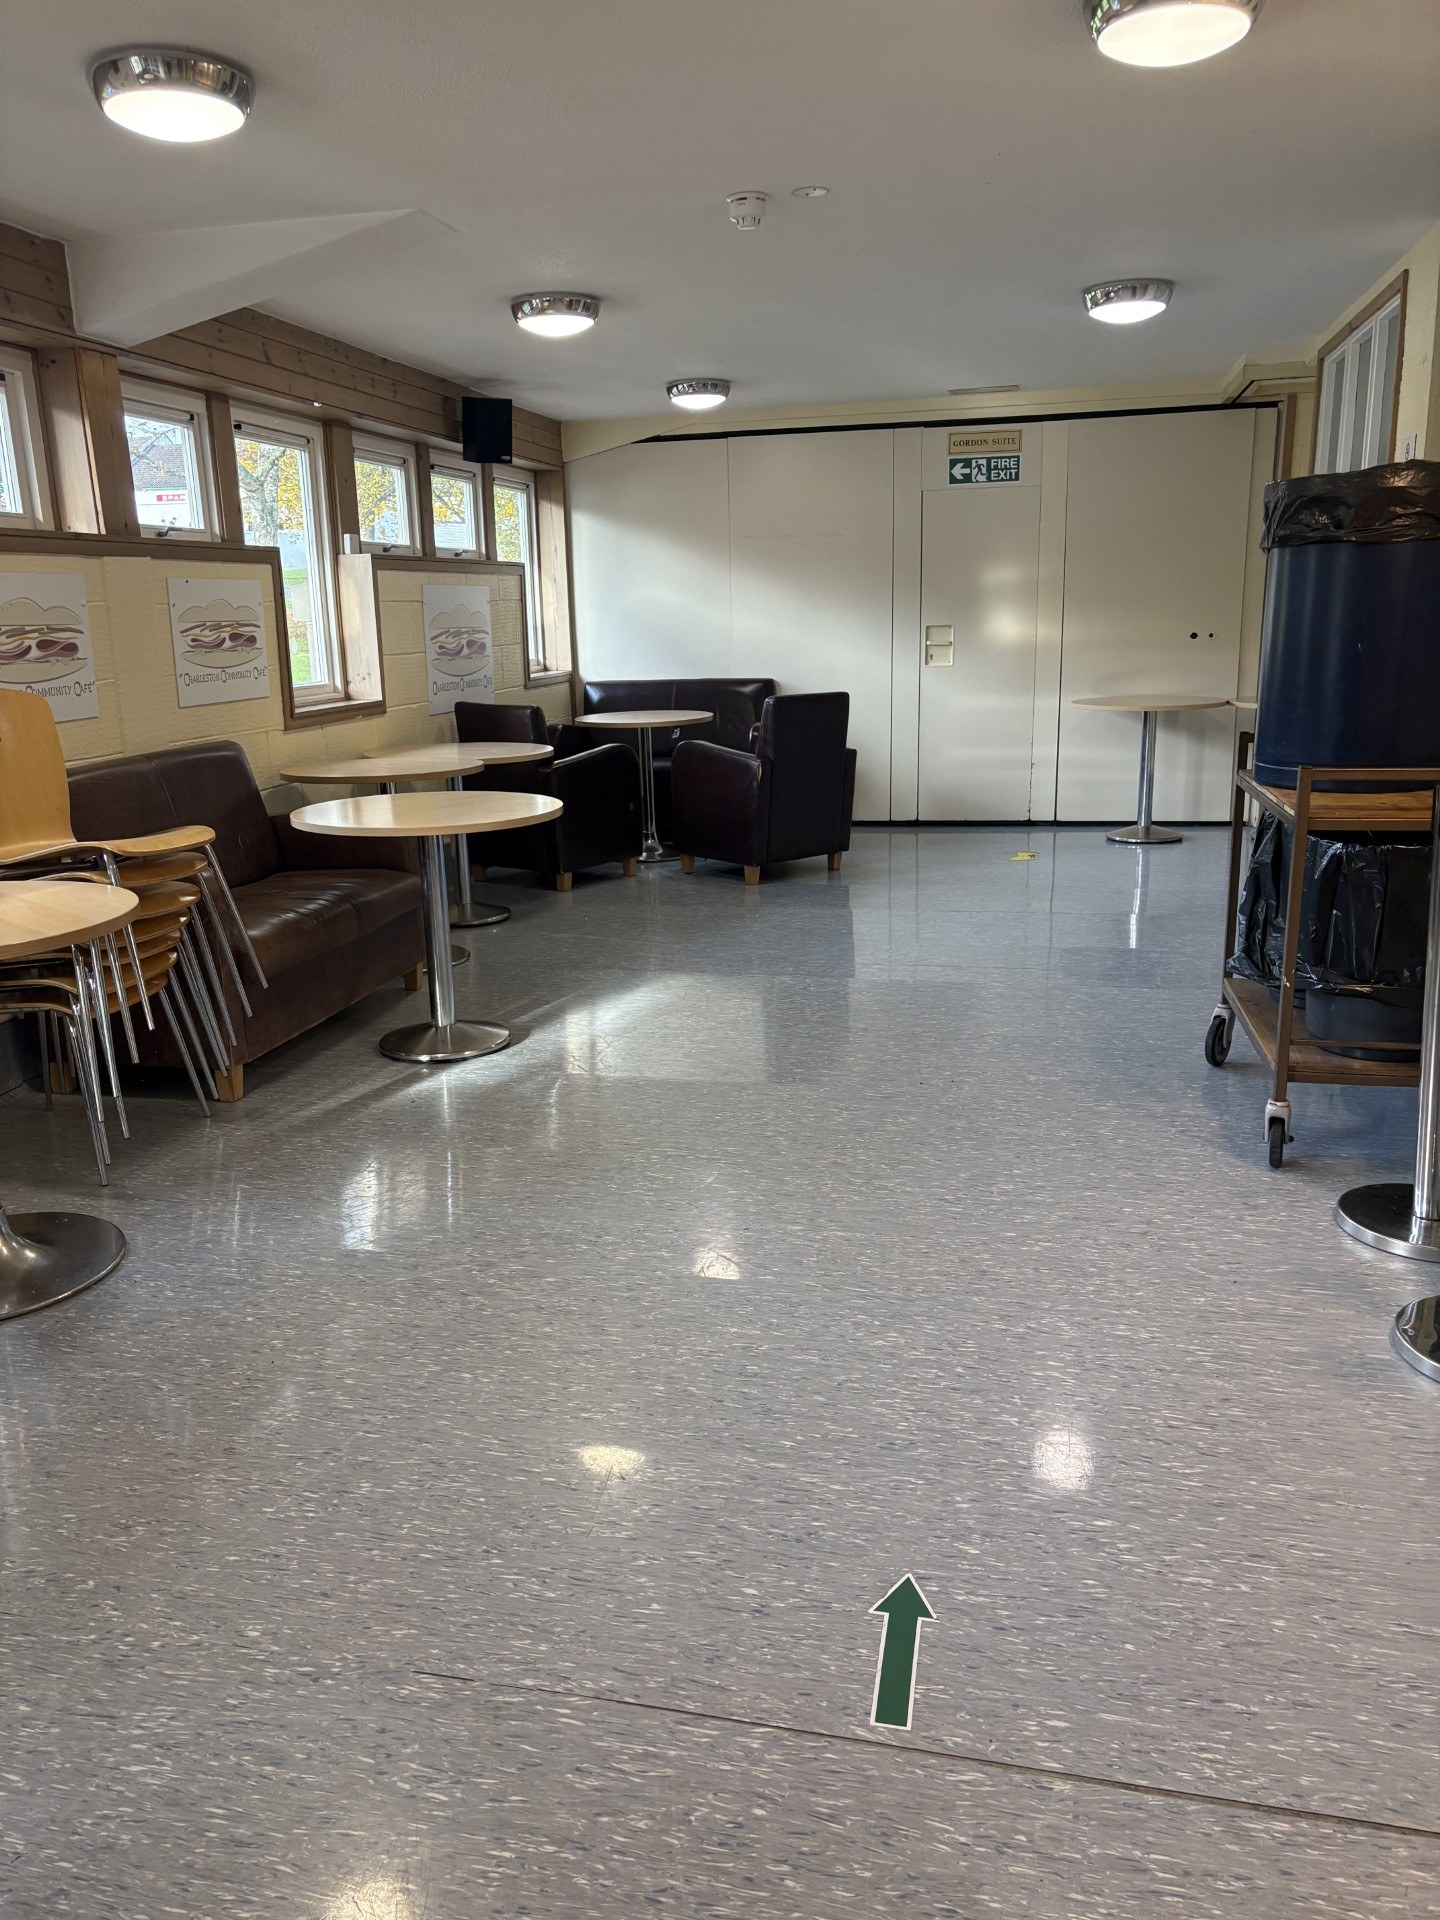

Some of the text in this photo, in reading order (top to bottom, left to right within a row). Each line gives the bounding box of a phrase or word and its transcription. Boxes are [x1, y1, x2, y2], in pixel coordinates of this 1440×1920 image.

[953, 437, 1017, 448] GORDON SUITE
[990, 458, 1018, 469] FIRE
[990, 469, 1018, 481] EXIT
